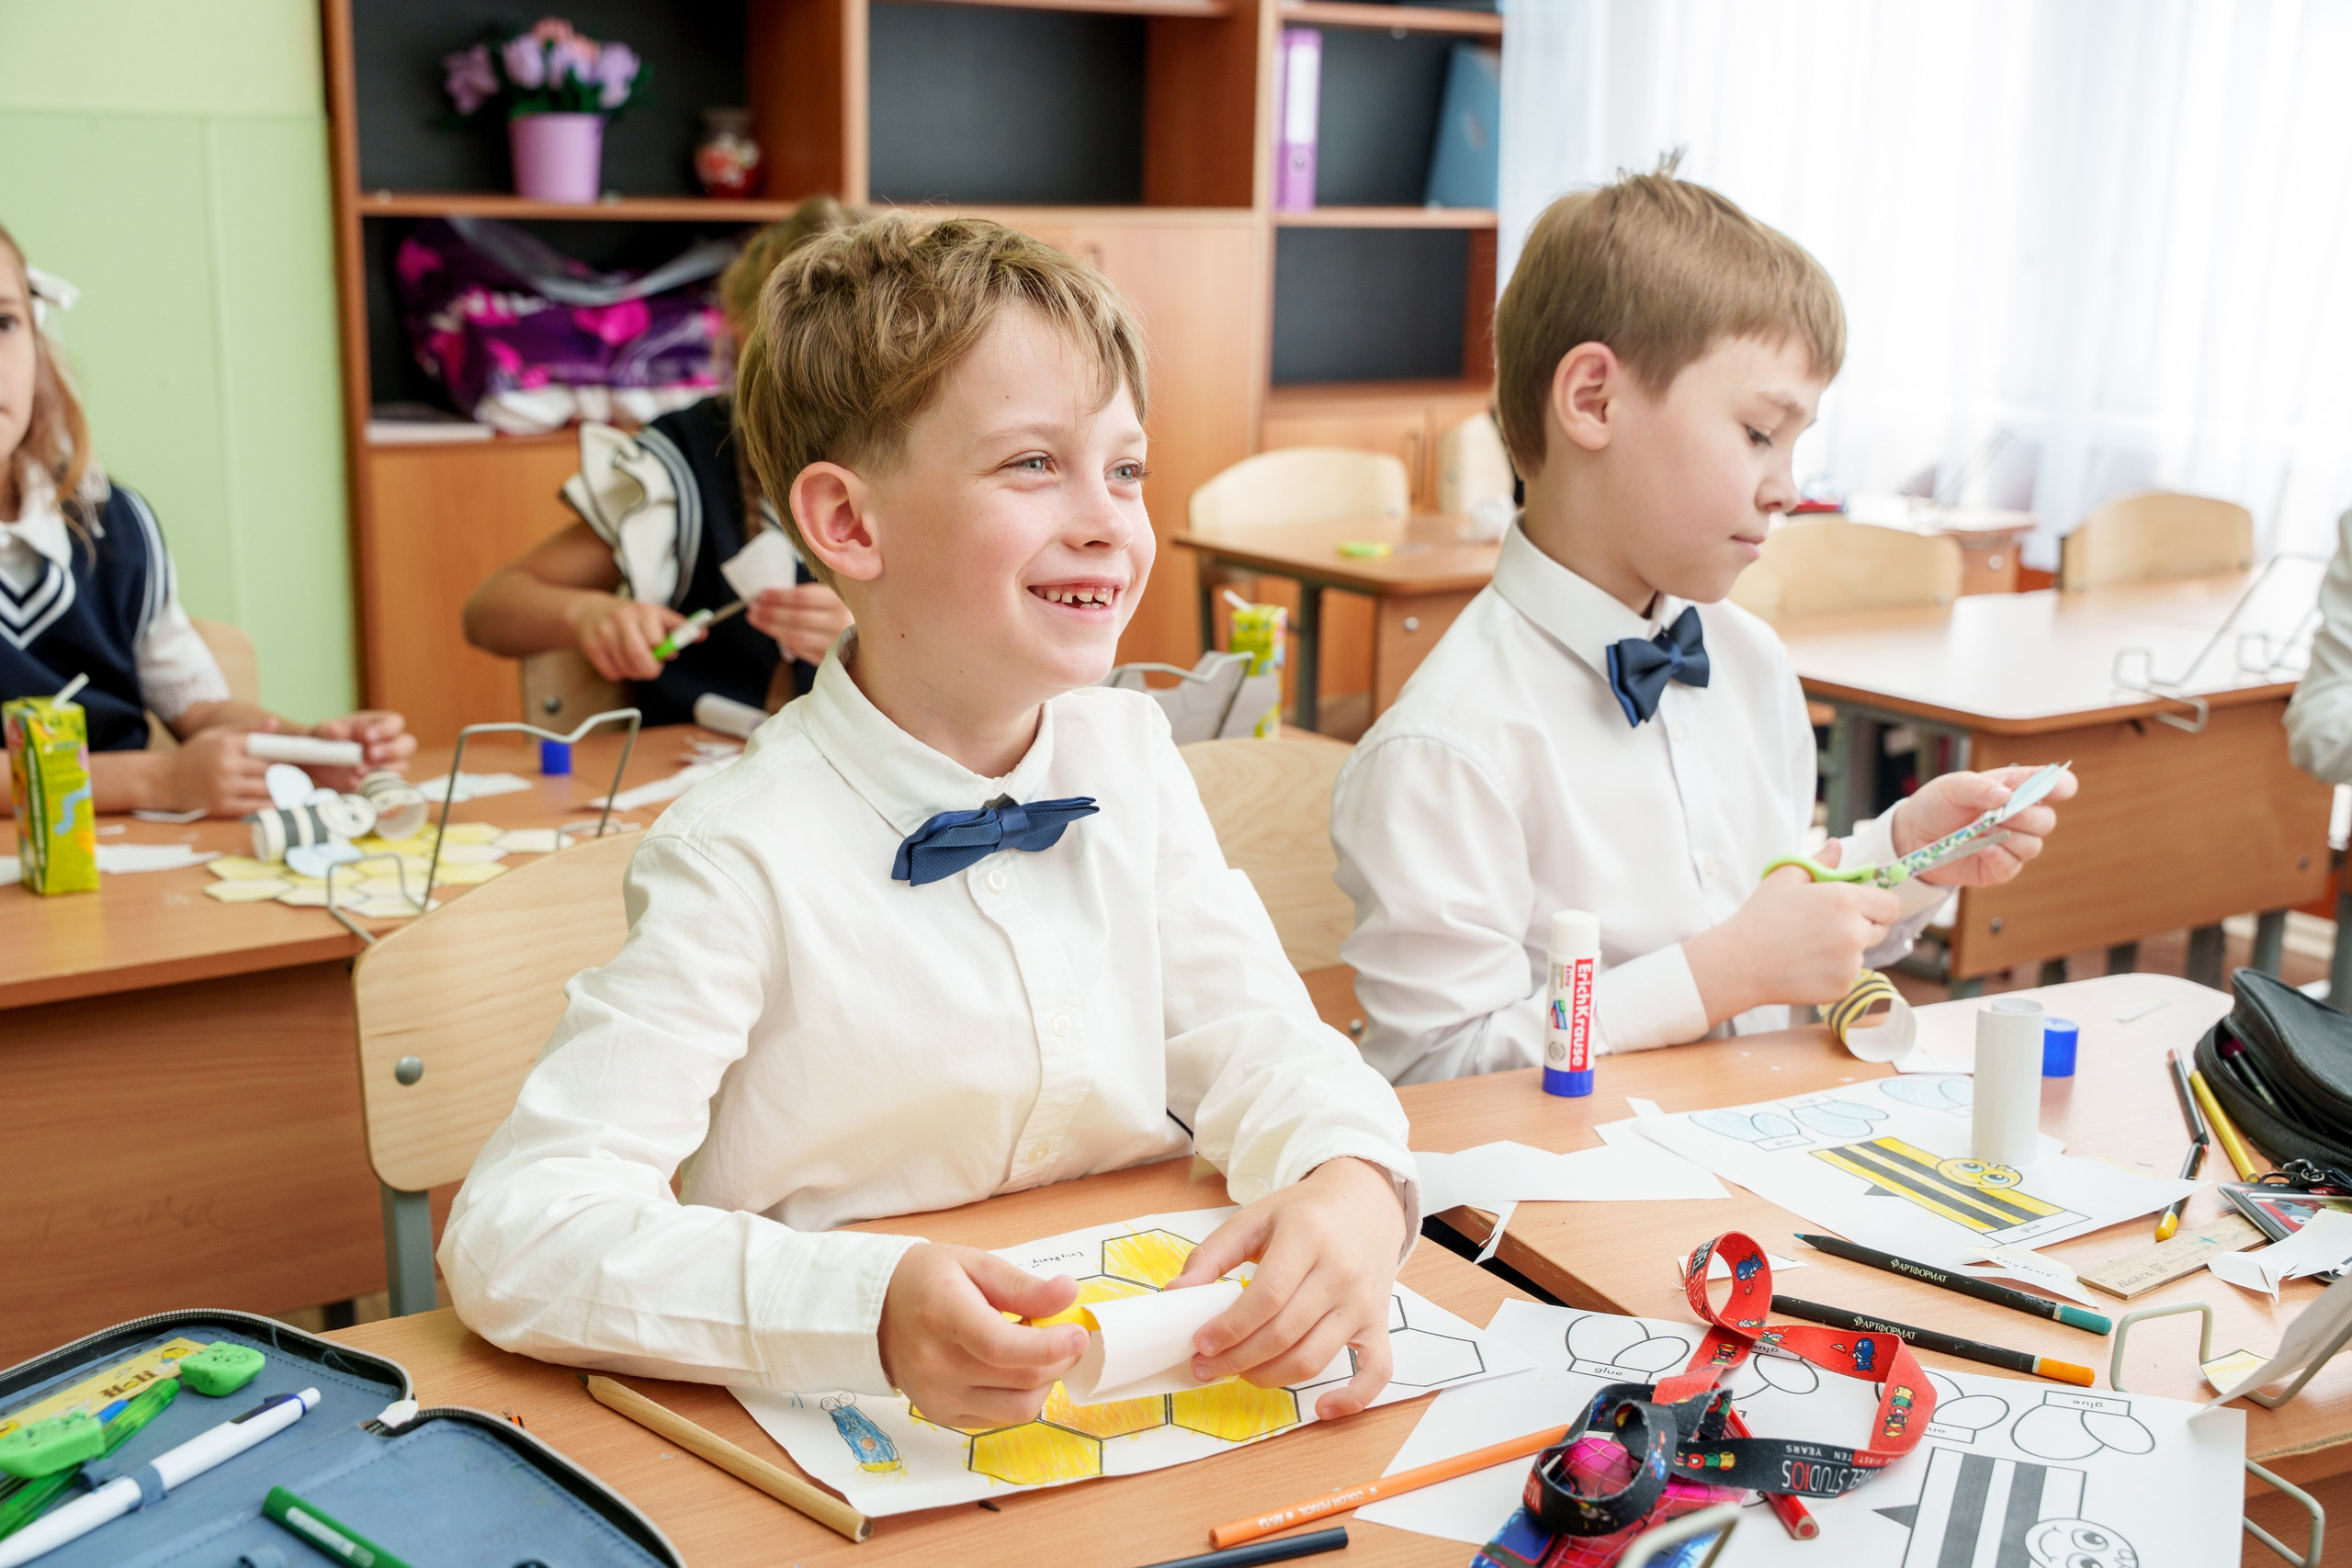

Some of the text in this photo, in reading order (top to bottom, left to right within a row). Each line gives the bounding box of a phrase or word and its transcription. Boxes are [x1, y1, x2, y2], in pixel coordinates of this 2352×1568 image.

[1572, 964, 1592, 1066] ErichKrause
[1898, 1262, 1948, 1283] АРТФОРМАТ
[1862, 1320, 1917, 1340] АРТФОРМАТ
[1594, 1367, 1623, 1376] glue
[2072, 1399, 2104, 1409] glue
[1785, 1444, 1822, 1457] YEARS
[1833, 1450, 1853, 1462] TEN
[1781, 1460, 1849, 1494] STUDIOS
[1332, 1490, 1364, 1506] COLOR
[1297, 1499, 1332, 1517] PENCIL
